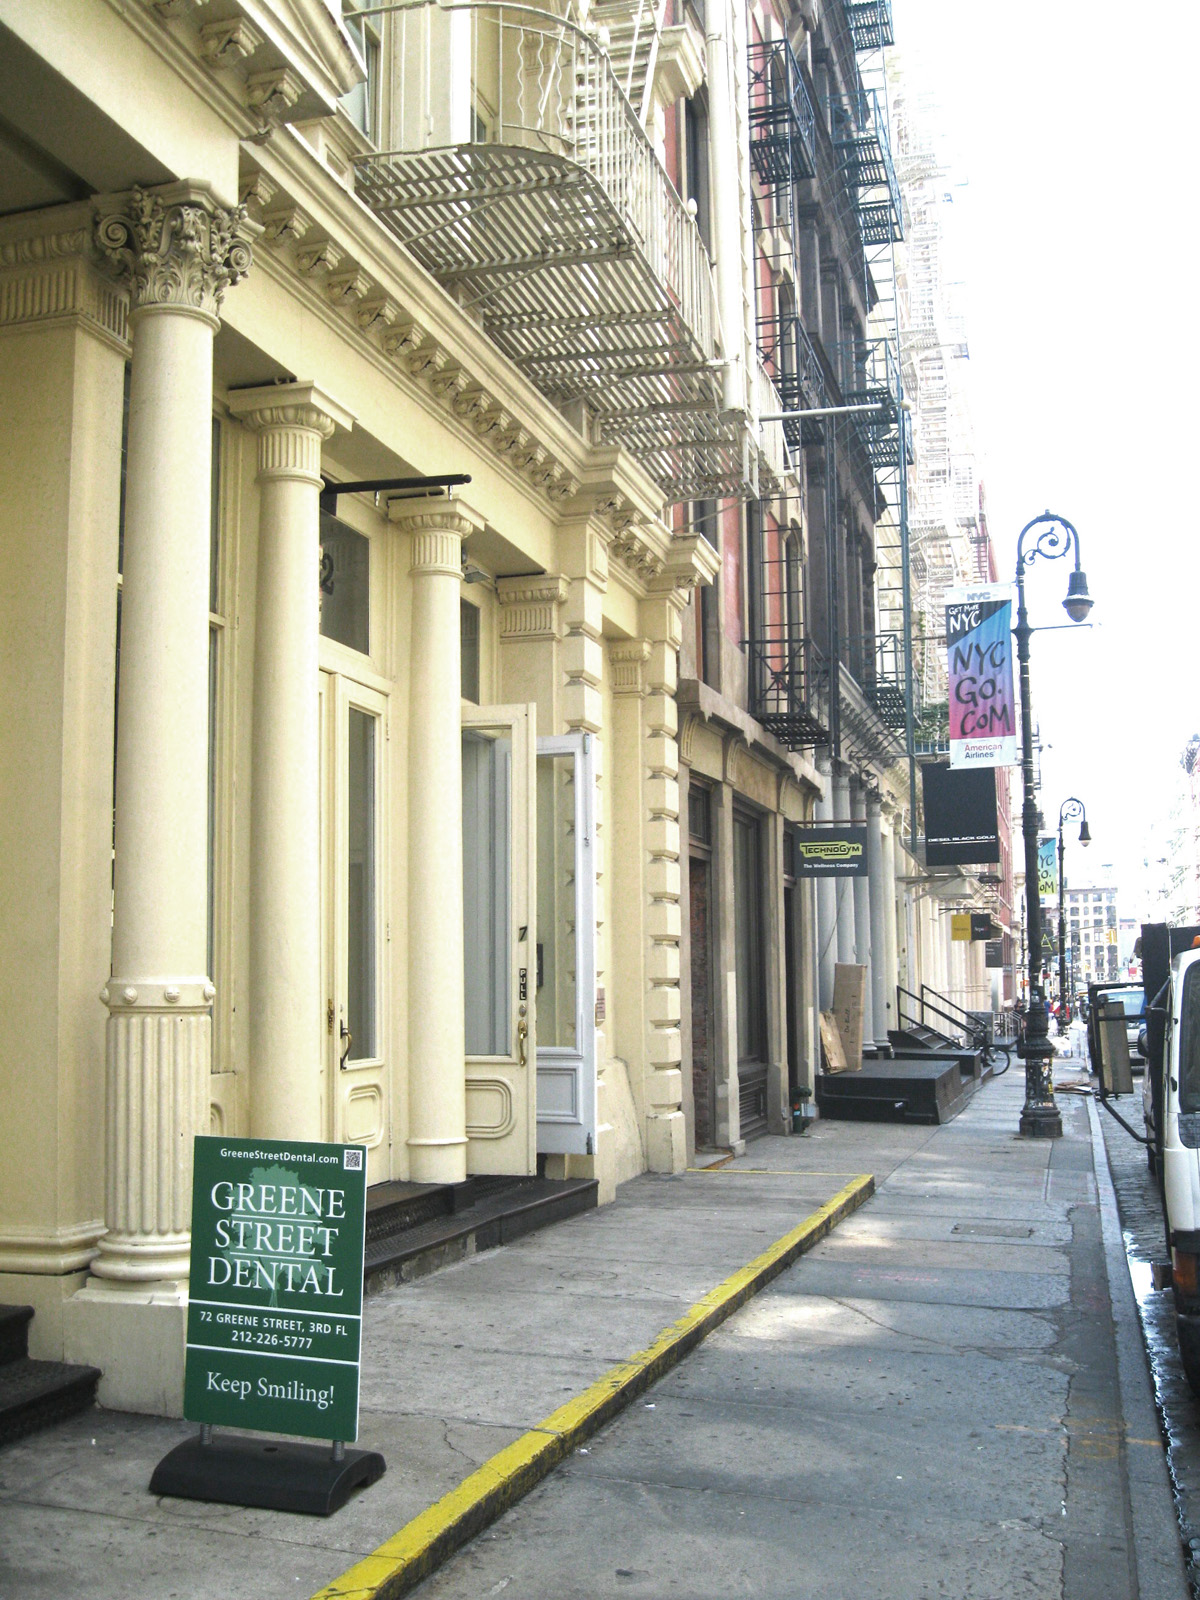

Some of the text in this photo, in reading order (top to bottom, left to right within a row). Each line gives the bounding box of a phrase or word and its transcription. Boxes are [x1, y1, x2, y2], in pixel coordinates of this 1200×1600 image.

[967, 592, 991, 601] NYC
[948, 606, 962, 615] GET
[950, 610, 981, 633] NYC
[953, 640, 1005, 675] NYC
[955, 676, 1002, 708] GO.
[964, 744, 1003, 752] American
[965, 751, 995, 759] Airlines
[1040, 854, 1053, 869] YC
[1040, 881, 1054, 893] OM
[518, 926, 528, 942] 7
[220, 1148, 339, 1164] GreeneStreetDental.com
[211, 1181, 346, 1218] GREENE
[215, 1219, 339, 1256] STREET
[207, 1256, 344, 1296] DENTAL
[200, 1311, 348, 1336] 72 GREENE STREET, 3RD FL
[231, 1330, 313, 1349] 212-226-5777
[206, 1371, 335, 1410] Keep Smiling!
